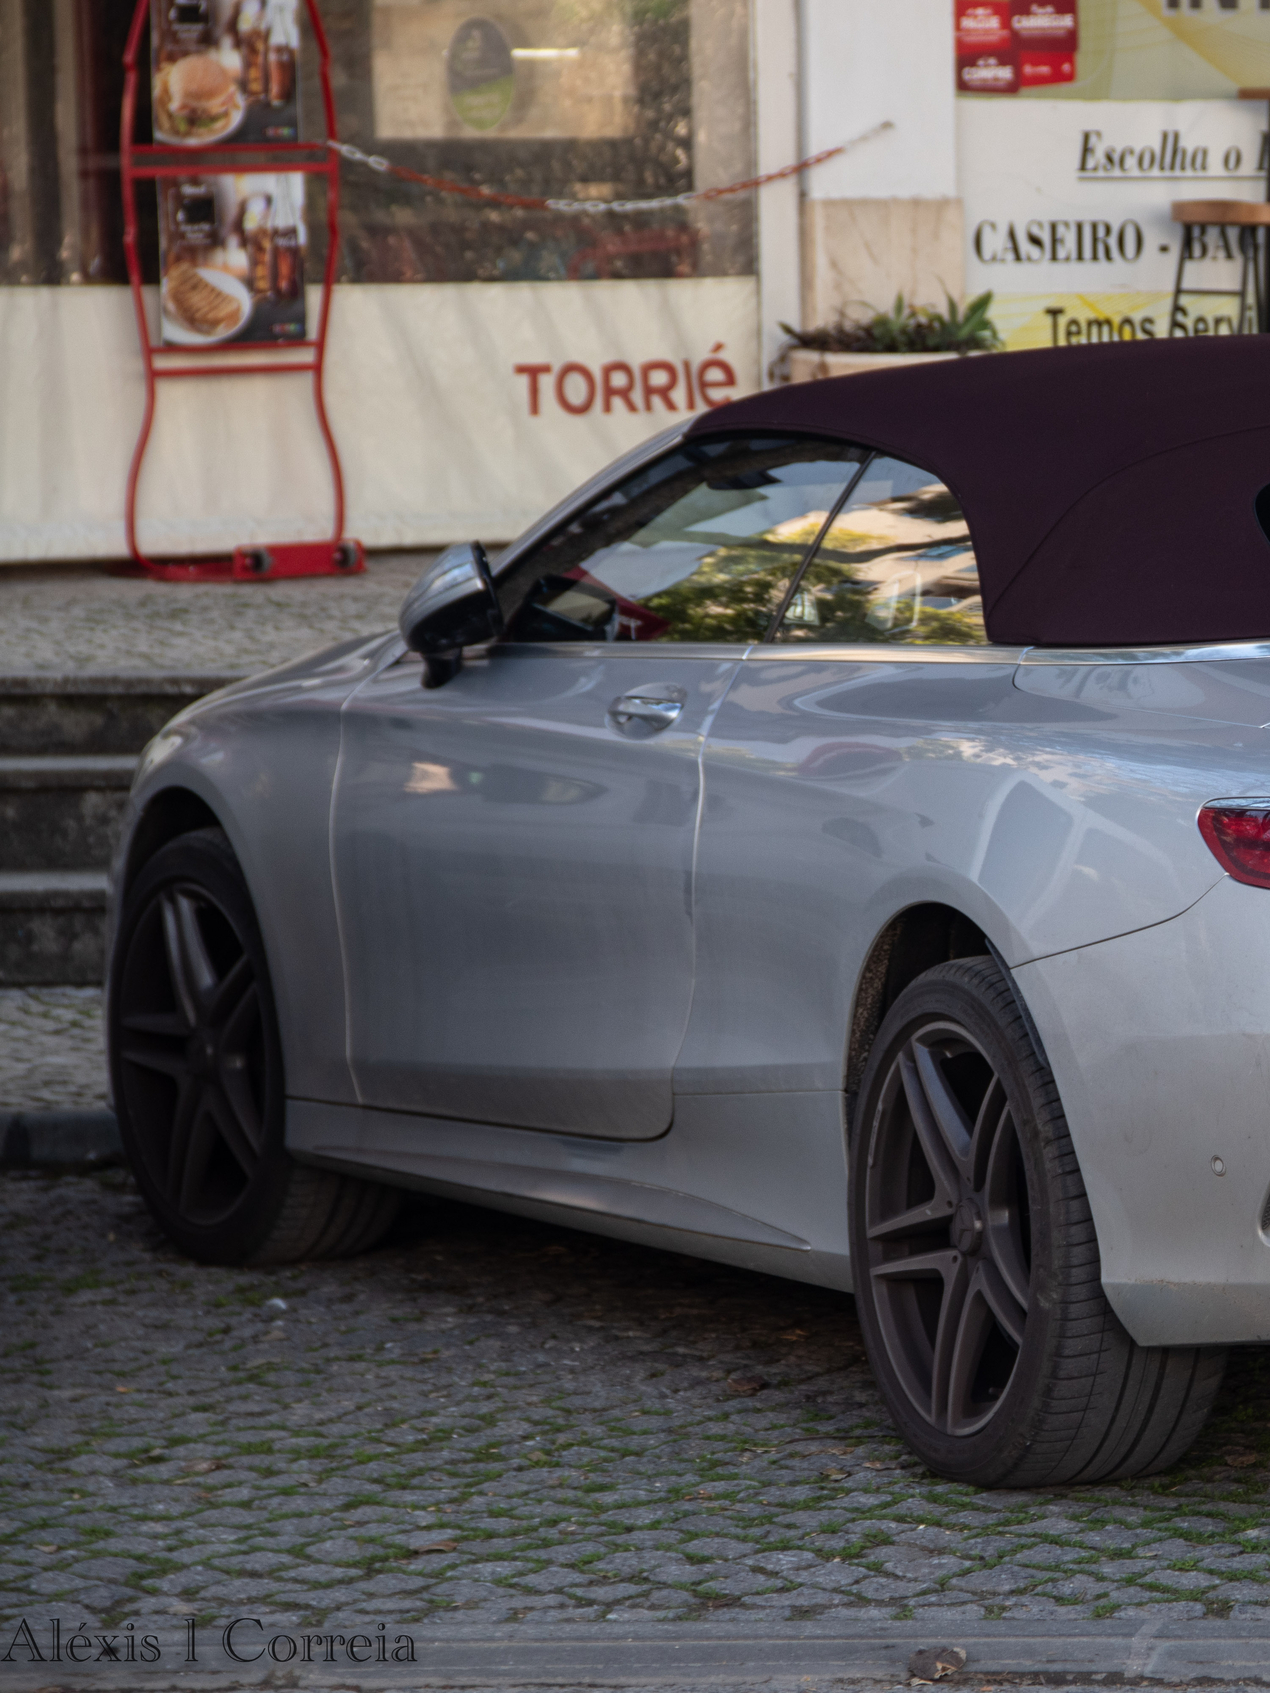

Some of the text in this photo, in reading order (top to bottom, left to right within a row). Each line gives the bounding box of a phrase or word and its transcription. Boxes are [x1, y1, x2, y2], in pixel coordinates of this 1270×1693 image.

[1077, 130, 1208, 173] Escolha
[1223, 145, 1242, 172] o
[973, 218, 1144, 264] CASEIRO
[1045, 306, 1155, 347] Temos
